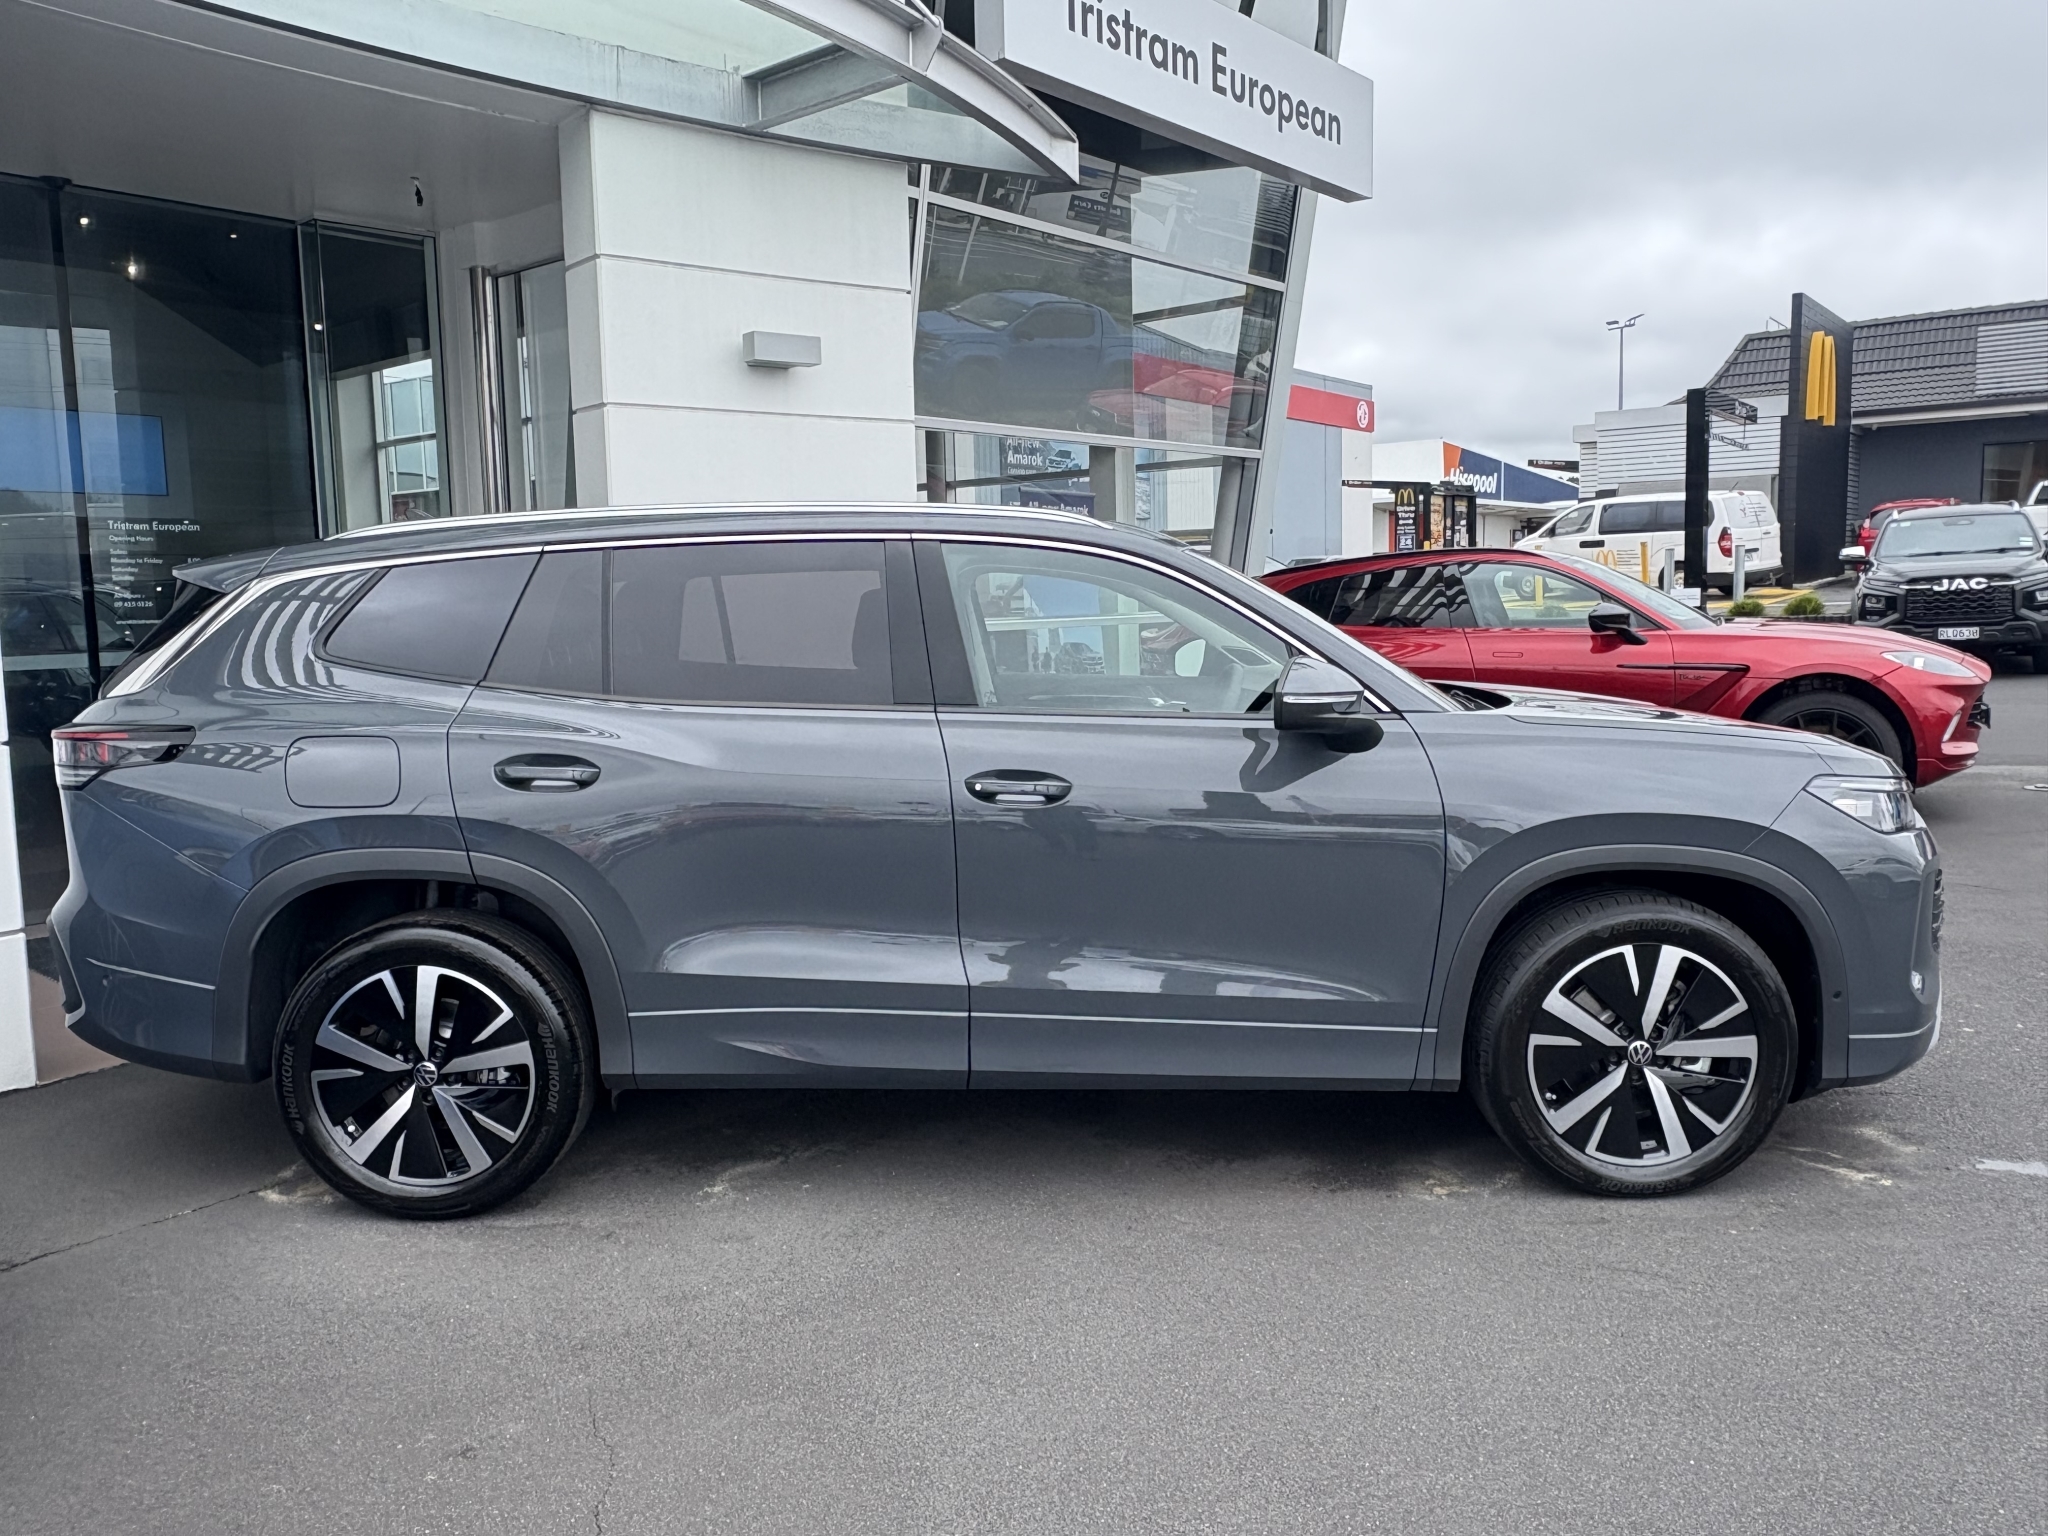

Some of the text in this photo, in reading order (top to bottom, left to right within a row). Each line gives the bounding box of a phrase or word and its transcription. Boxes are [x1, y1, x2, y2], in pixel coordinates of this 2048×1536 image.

[1212, 41, 1341, 146] European
[1007, 449, 1044, 467] Amarok
[107, 520, 201, 533] Tristram European
[1932, 577, 1990, 592] JAC
